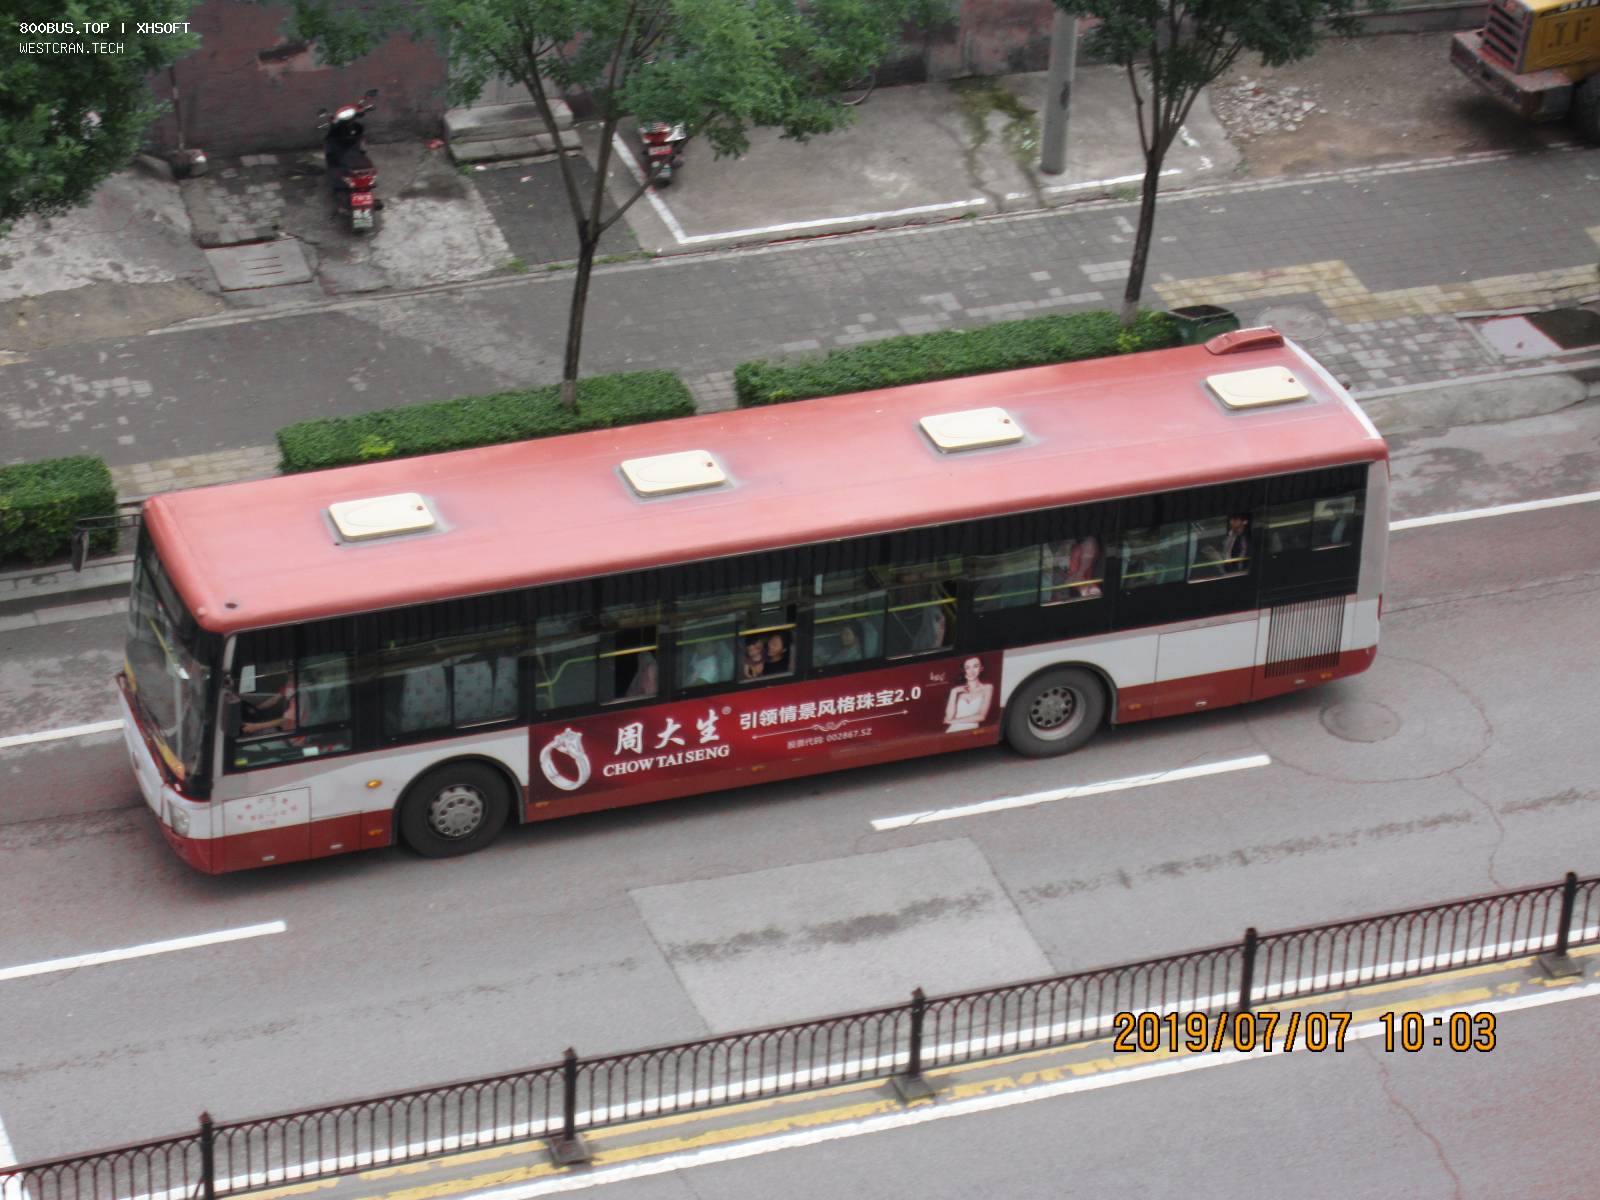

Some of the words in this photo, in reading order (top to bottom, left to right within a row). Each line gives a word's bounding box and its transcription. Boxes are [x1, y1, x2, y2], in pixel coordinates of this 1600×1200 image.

[739, 686, 922, 731] 引领情景风格珠宝2.0
[613, 708, 720, 756] 周大生
[602, 757, 654, 777] CHOW
[655, 752, 684, 768] TAI
[685, 744, 730, 764] SENG
